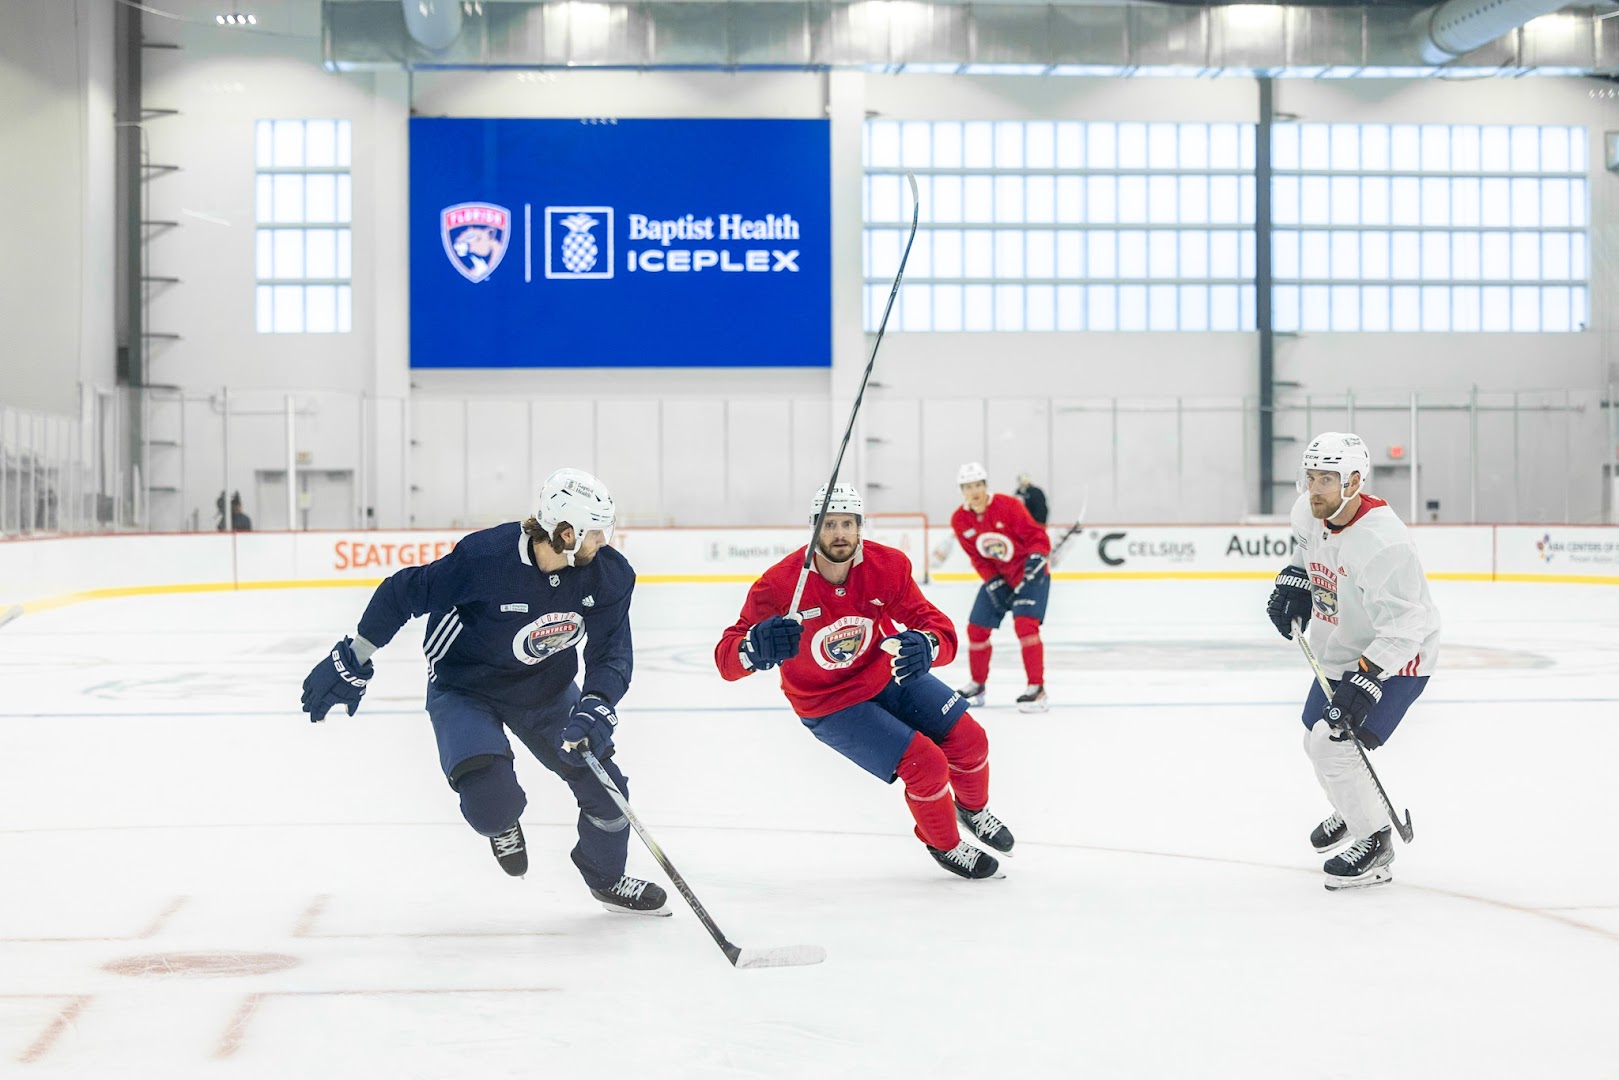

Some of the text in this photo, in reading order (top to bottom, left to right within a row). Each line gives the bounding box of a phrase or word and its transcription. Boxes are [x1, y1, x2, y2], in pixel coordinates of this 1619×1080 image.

[628, 213, 800, 246] Baptist Health
[627, 249, 800, 272] ICEPLEX
[1128, 541, 1196, 557] CELSIUS
[535, 624, 573, 637] PANTHERS
[331, 649, 368, 687] BAUE
